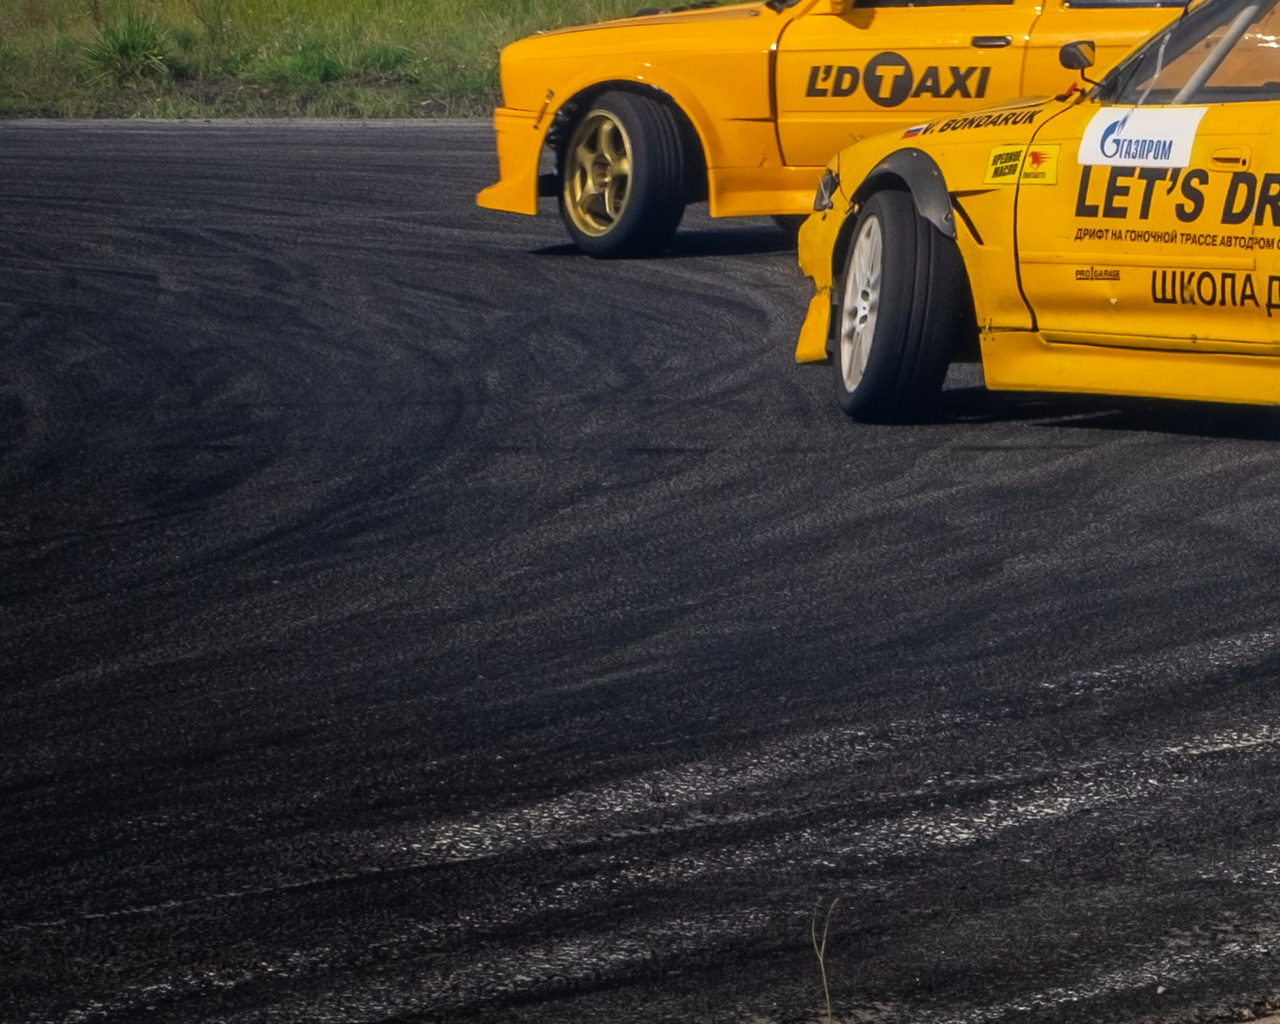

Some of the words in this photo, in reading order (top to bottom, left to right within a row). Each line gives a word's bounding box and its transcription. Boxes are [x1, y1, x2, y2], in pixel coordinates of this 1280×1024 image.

[875, 65, 992, 98] TAXI
[938, 109, 1043, 133] BONDARUK
[1119, 139, 1174, 161] ГАЗПРОМ
[1075, 166, 1210, 224] LET'S
[1074, 228, 1110, 242] ДРИФТ
[1110, 229, 1123, 241] НА
[1124, 230, 1178, 244] ГОНОЧНОЙ
[1180, 233, 1218, 247] ТРАССЕ
[1219, 236, 1275, 251] АВТОДРОМ
[1151, 270, 1260, 308] ШКОЛА
